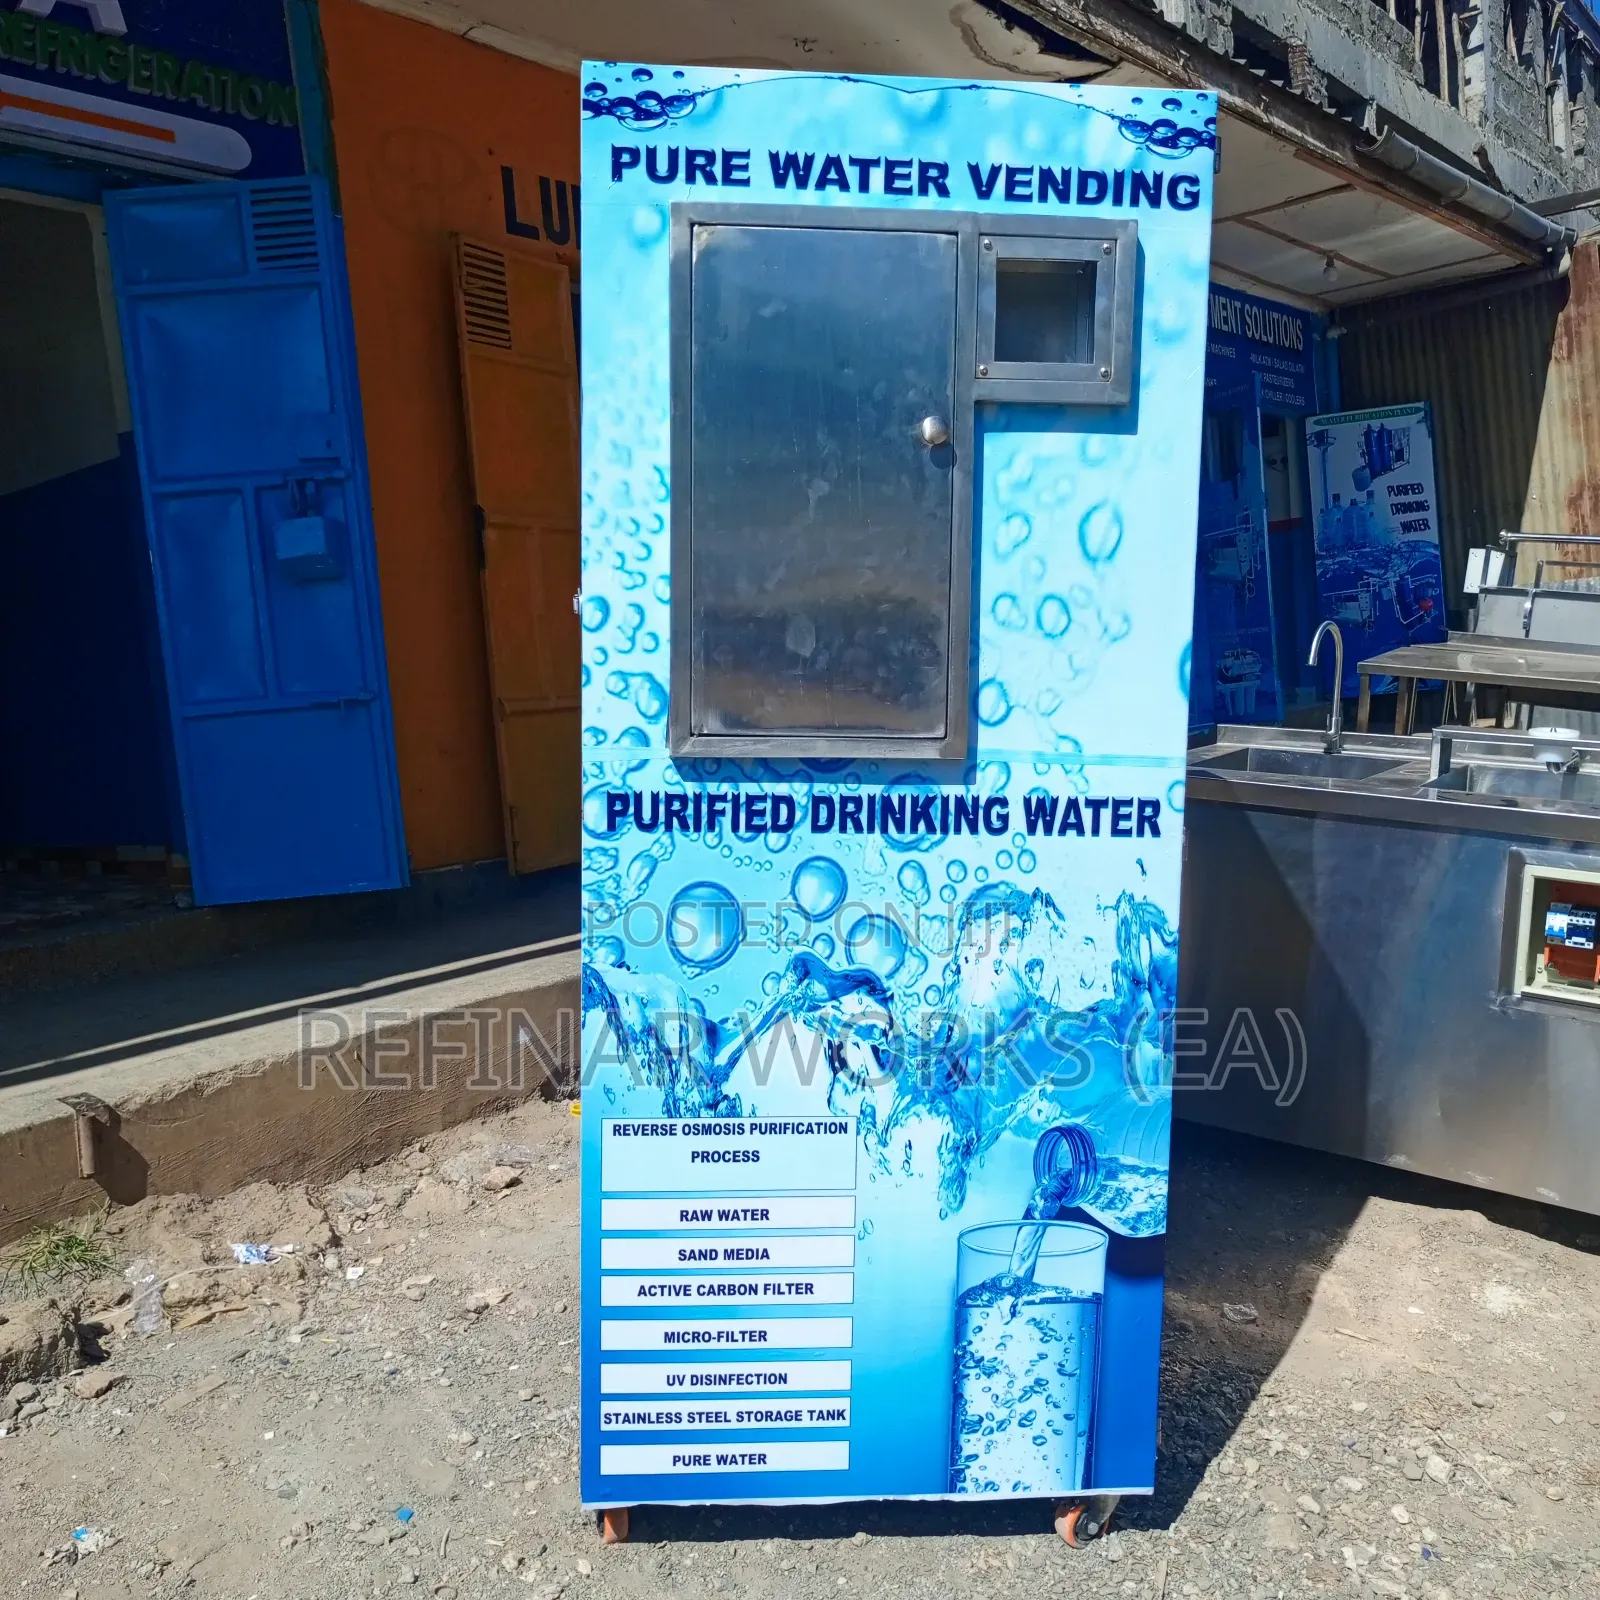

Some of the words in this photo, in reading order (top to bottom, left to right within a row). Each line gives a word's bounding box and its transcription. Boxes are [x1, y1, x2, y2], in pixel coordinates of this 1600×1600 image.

[611, 143, 750, 187] PURE
[768, 149, 951, 199] WATER
[967, 161, 1200, 211] VENDING
[1244, 303, 1304, 351] SOLUTIONS
[1386, 483, 1424, 498] PURIFIED
[1390, 500, 1430, 516] DRINKING
[1400, 517, 1431, 535] WATER
[606, 790, 796, 834] PURIFIED
[810, 791, 1010, 836] DRINKING
[1023, 794, 1162, 838] WATER
[612, 1123, 677, 1136] REVERSE
[682, 1122, 745, 1136] OSMOSIS
[750, 1121, 848, 1135] PURIFICATION
[691, 1150, 760, 1163] PROCESS
[680, 1209, 713, 1222] RAW
[717, 1208, 770, 1221] WATER
[678, 1249, 718, 1261] SAND
[723, 1248, 770, 1261] MEDIA
[637, 1284, 692, 1297] ACTIVE
[697, 1283, 758, 1296] CARBON
[763, 1283, 814, 1295] FILTER
[664, 1330, 768, 1343] MICRO-FILTER
[666, 1374, 686, 1386] UV
[690, 1373, 788, 1386] DISINFECTION
[603, 1412, 682, 1424] STAINLESS
[687, 1411, 731, 1423] STEEL
[736, 1410, 803, 1423] STORAGE
[807, 1409, 846, 1421] TANK
[672, 1454, 711, 1467] PURE
[716, 1453, 767, 1466] WATER
